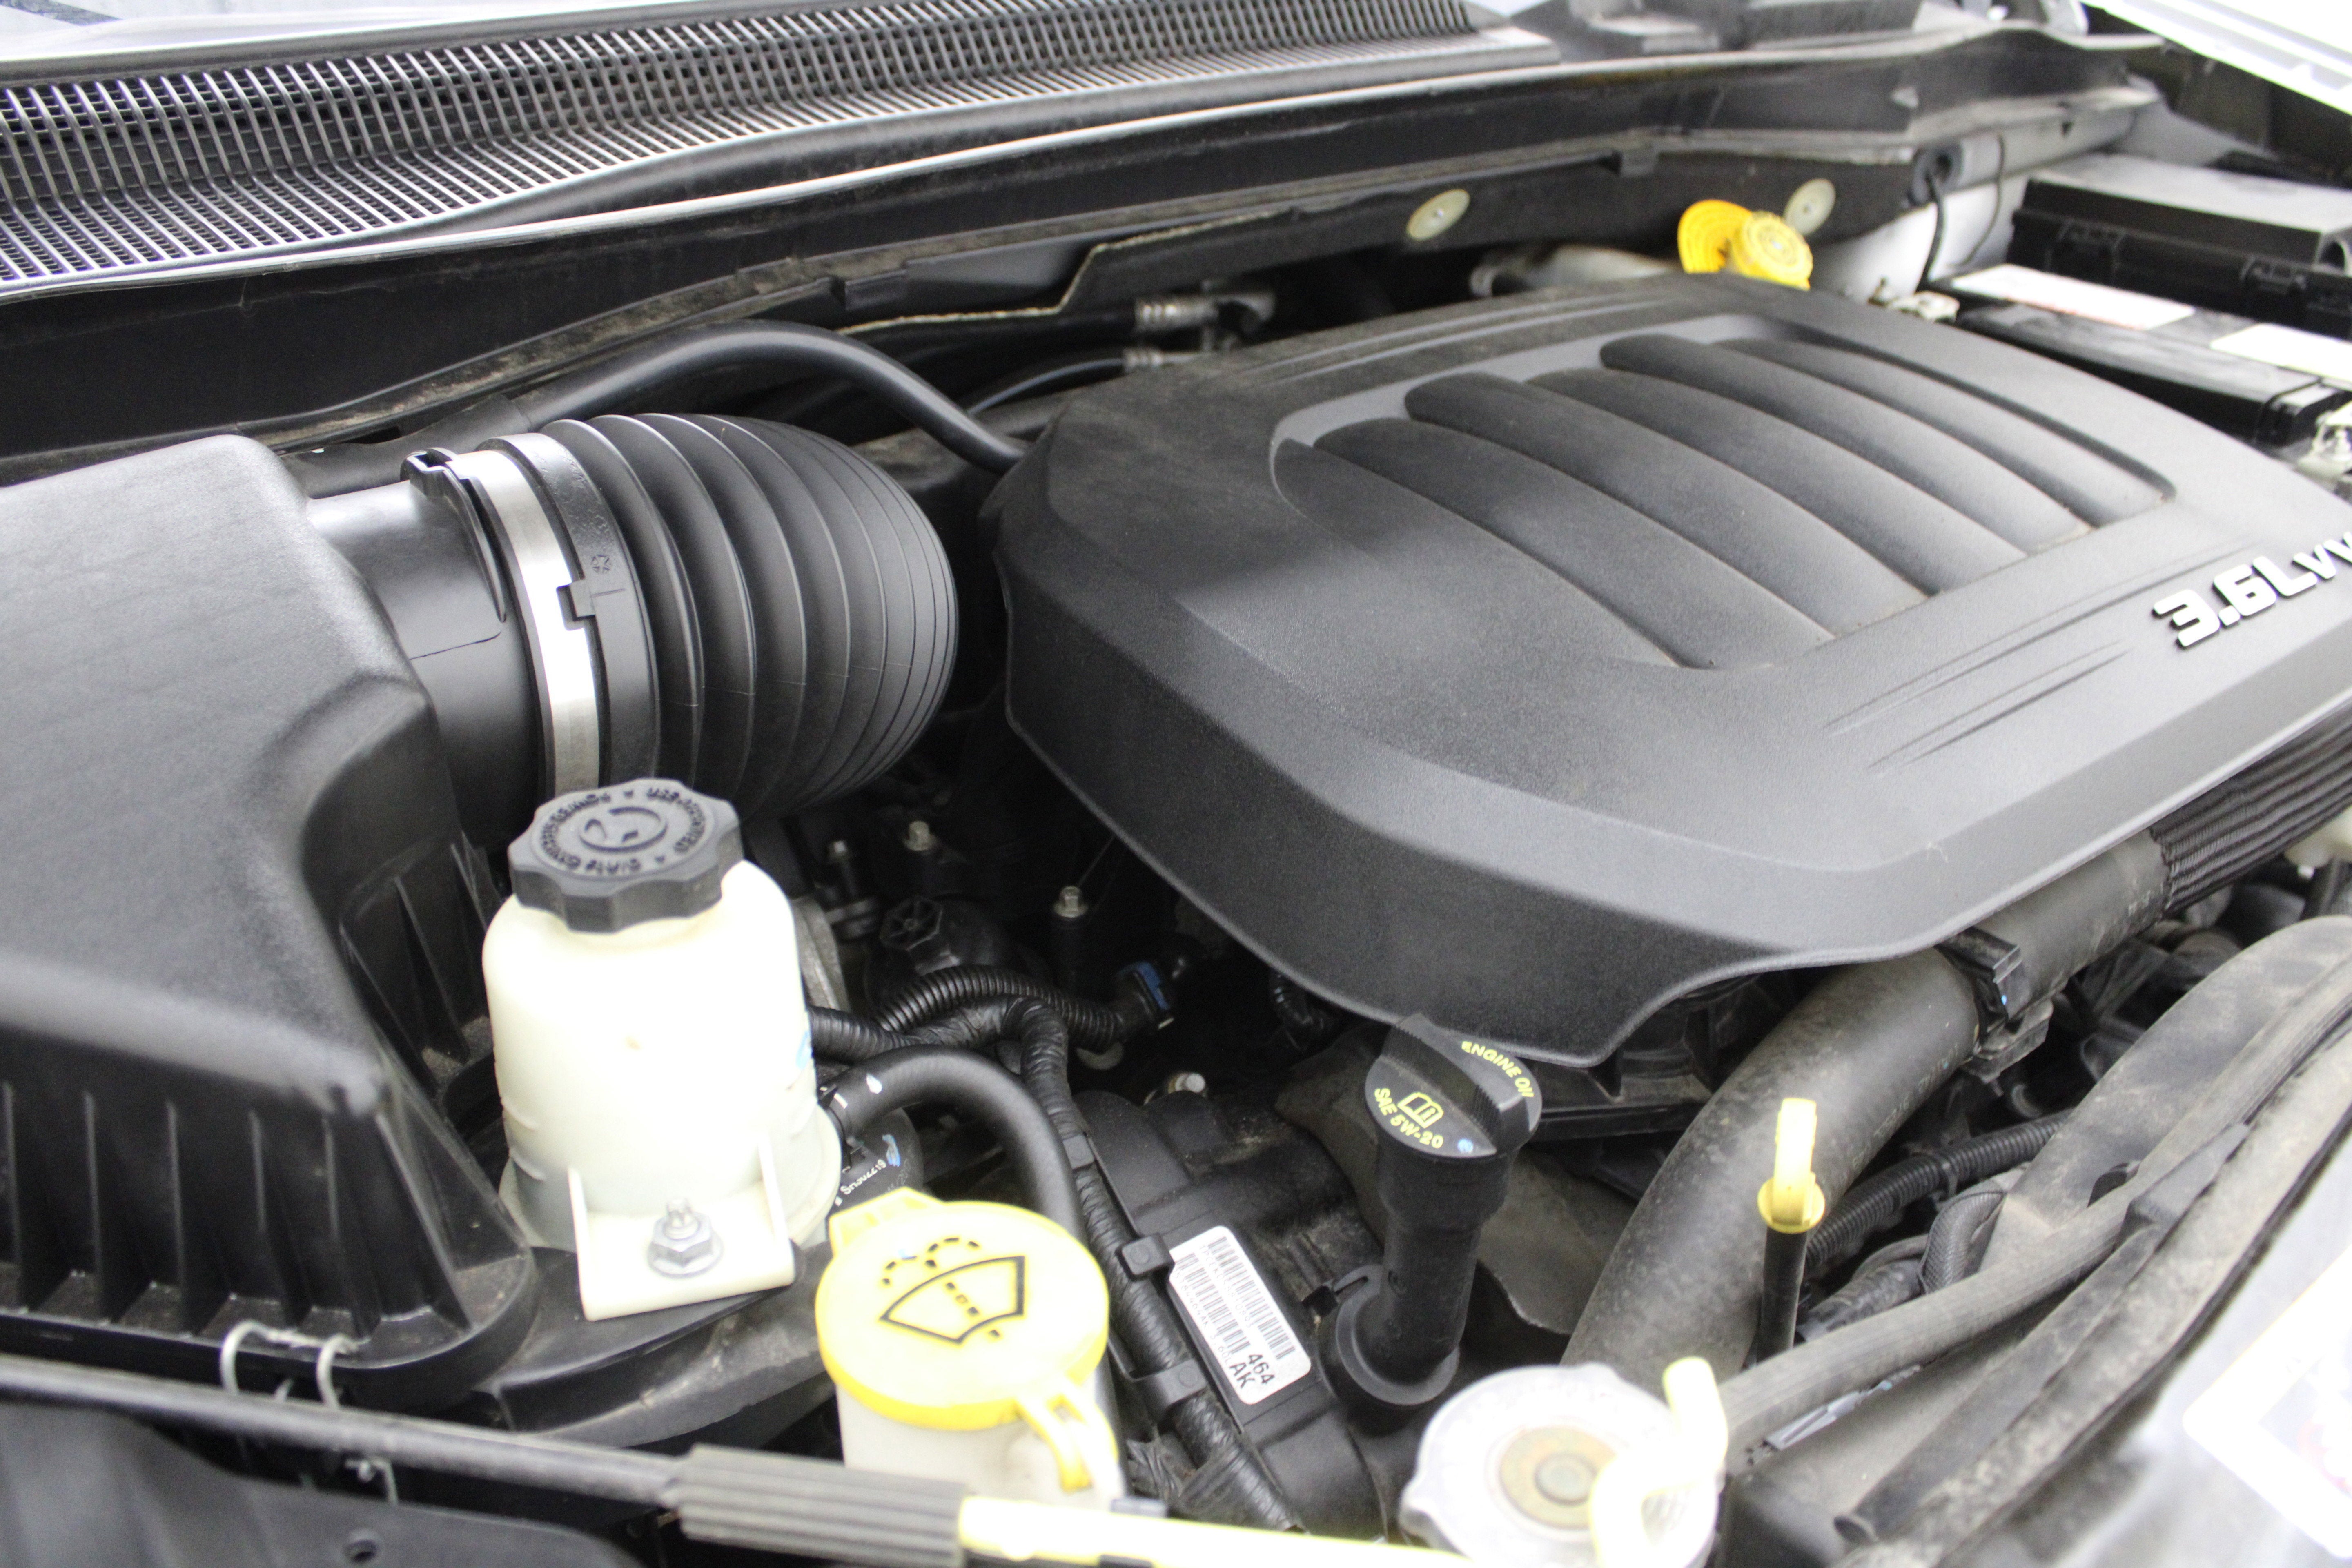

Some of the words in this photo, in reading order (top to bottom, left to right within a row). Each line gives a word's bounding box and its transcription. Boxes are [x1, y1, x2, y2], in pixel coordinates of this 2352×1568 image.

[1461, 1041, 1522, 1077] ENGINE
[1374, 1088, 1398, 1116] SAE
[1390, 1114, 1444, 1148] 5W-20
[1229, 1362, 1255, 1388] AK
[1249, 1354, 1275, 1384] 464
